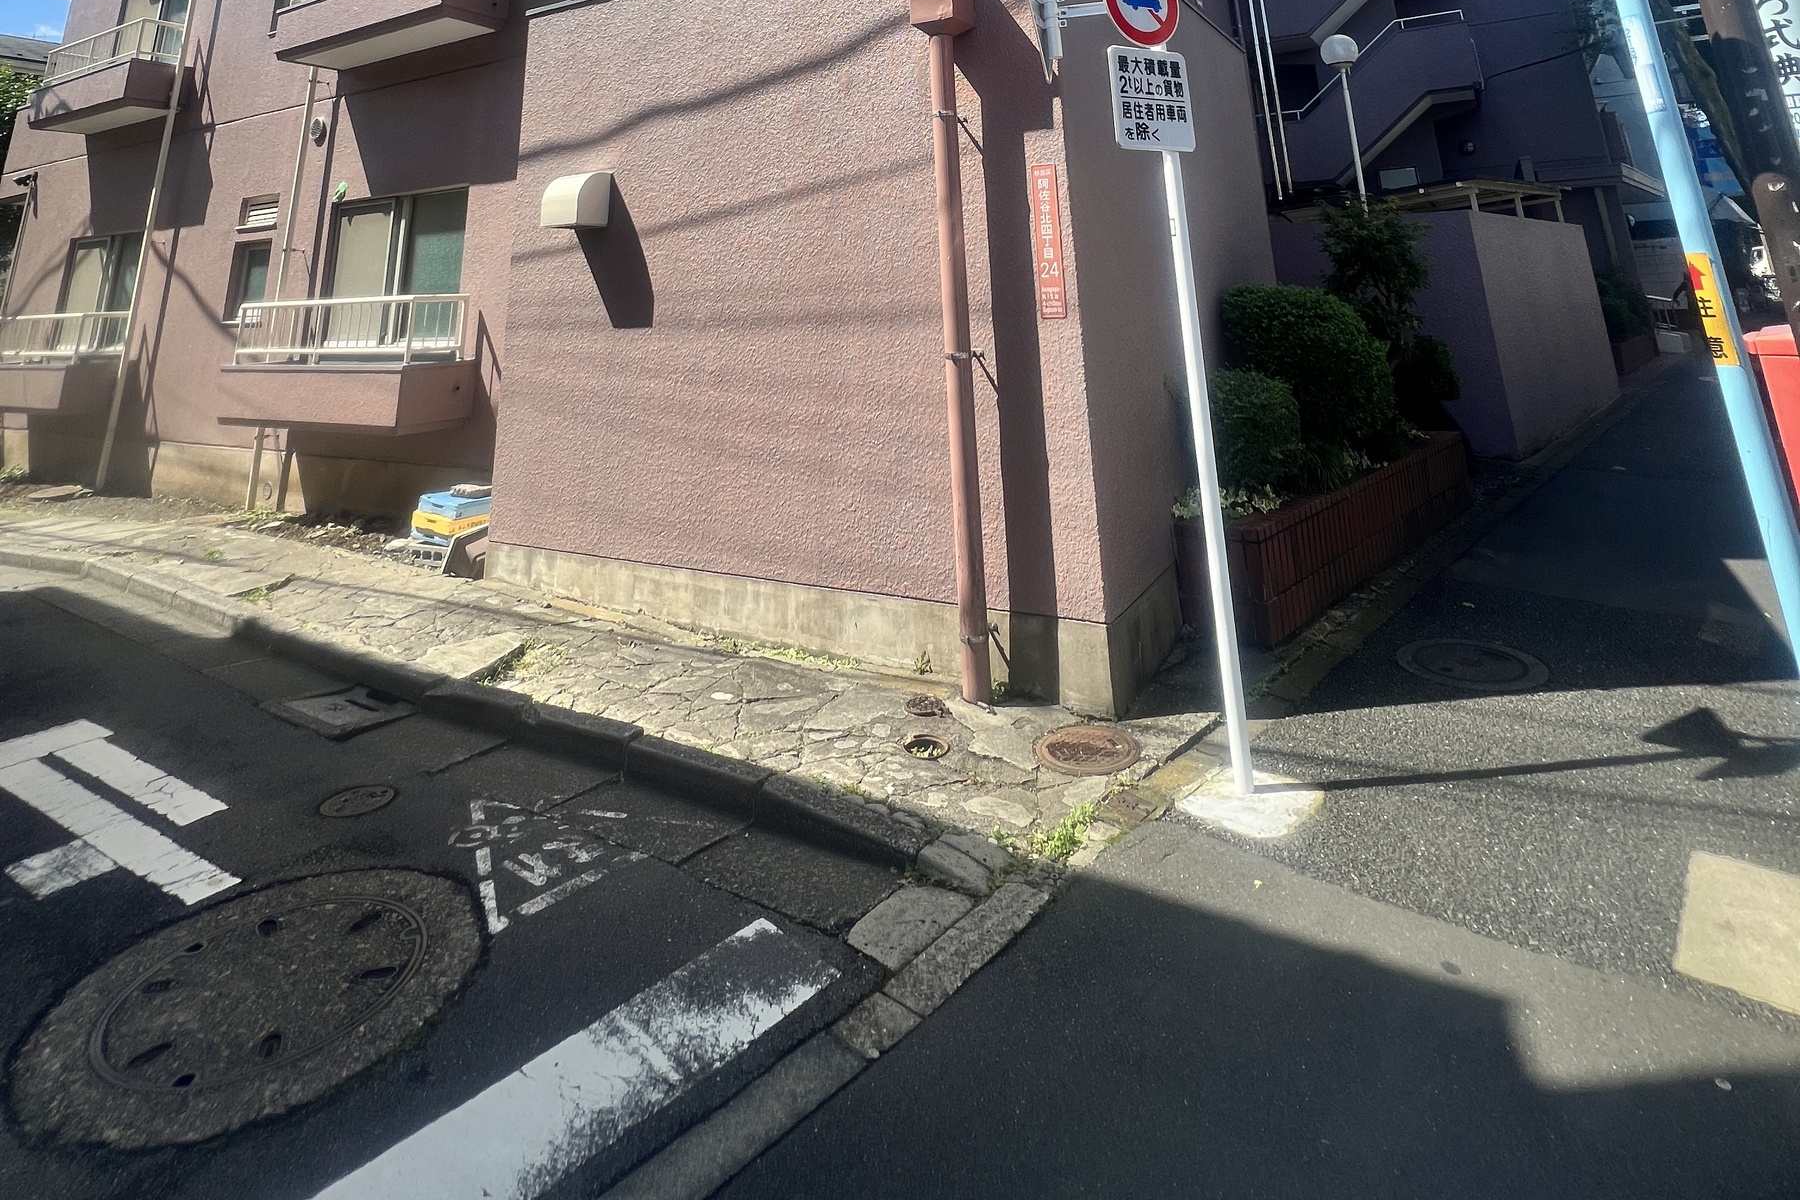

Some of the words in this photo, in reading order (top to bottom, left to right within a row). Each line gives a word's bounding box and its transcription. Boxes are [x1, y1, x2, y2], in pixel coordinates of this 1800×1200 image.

[1117, 55, 1182, 79] 最大積載量
[1122, 101, 1187, 123] 居住者用車両
[1125, 122, 1161, 142] を除く
[1037, 178, 1054, 259] 阿佐谷北四丁目
[1040, 261, 1060, 278] 24
